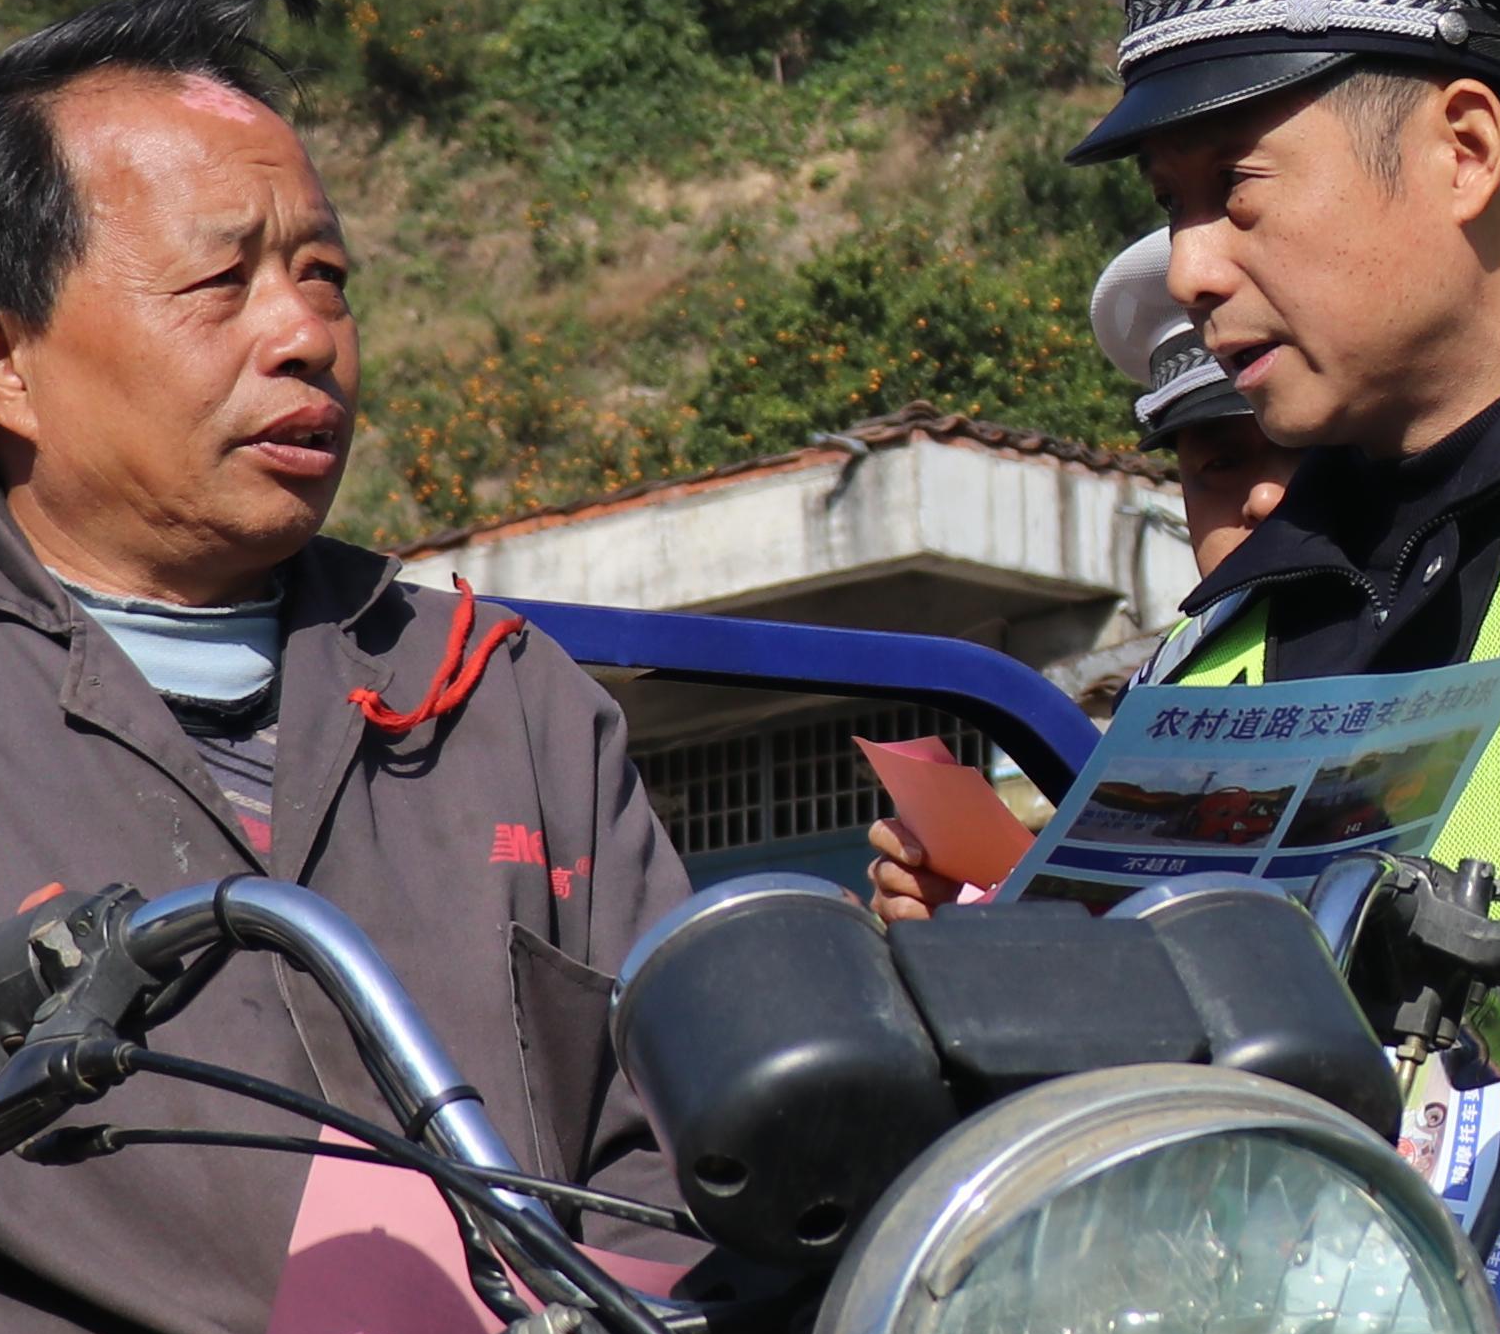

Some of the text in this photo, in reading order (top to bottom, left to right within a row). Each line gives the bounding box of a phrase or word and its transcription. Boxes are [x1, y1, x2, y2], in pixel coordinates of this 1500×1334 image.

[1146, 675, 1500, 742] 农村道路交通安全知识
[1122, 856, 1185, 873] 不超员
